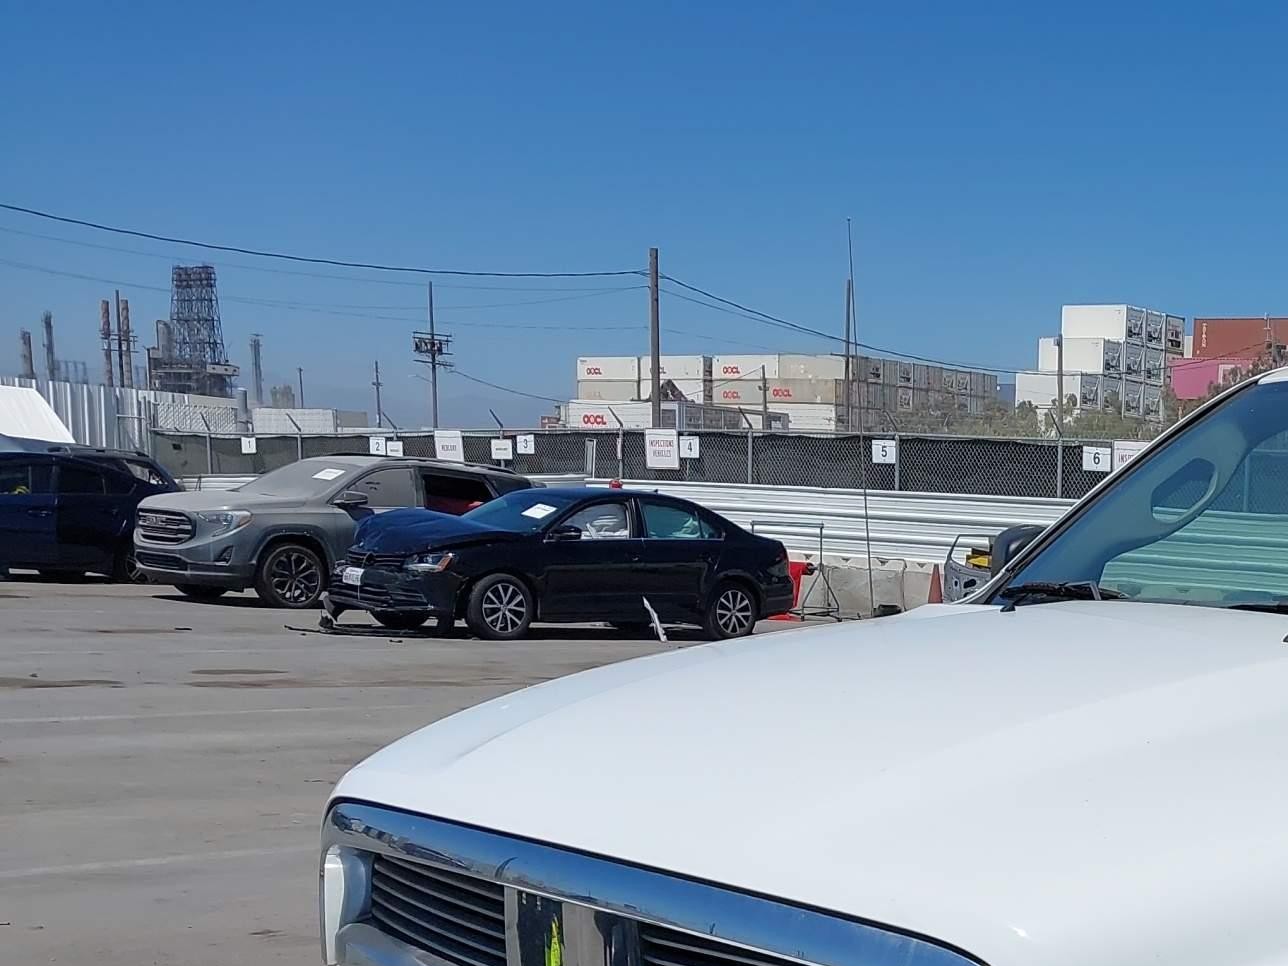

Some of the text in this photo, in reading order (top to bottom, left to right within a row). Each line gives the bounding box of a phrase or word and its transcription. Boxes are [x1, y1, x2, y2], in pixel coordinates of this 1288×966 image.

[586, 367, 603, 376] OOCL
[722, 366, 741, 375] OOCL
[722, 390, 741, 400] OOCL
[772, 388, 793, 398] OOCL
[582, 414, 608, 426] OOCL
[375, 441, 380, 452] 2
[523, 438, 529, 449] 3
[687, 441, 693, 453] 4
[881, 445, 888, 458] 5
[1093, 451, 1101, 465] 6
